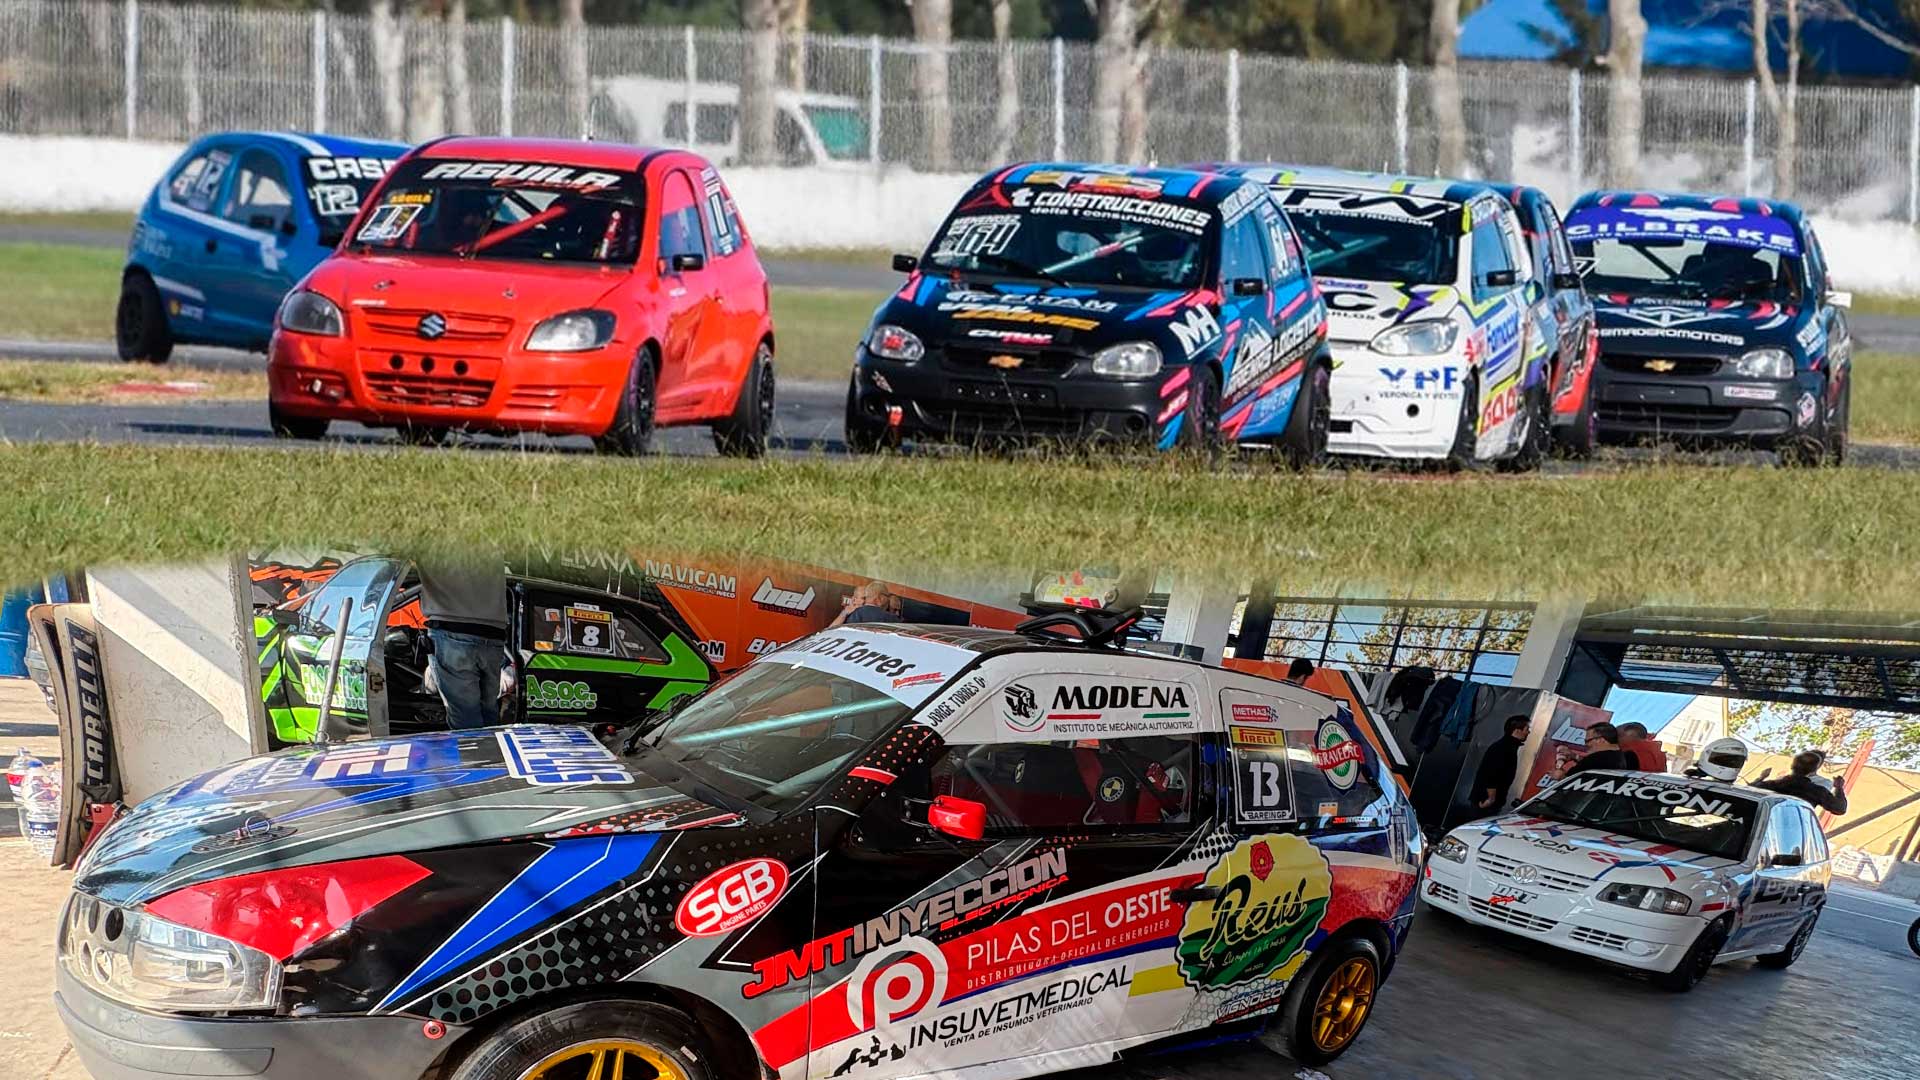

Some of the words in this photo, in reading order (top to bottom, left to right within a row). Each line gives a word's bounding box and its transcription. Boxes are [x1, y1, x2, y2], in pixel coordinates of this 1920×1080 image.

[422, 163, 621, 188] AGUILA
[1034, 191, 1211, 228] CONSTRUCCIONES
[1378, 366, 1458, 390] YPF
[645, 559, 737, 593] NAVICAM
[582, 625, 600, 647] 8
[926, 697, 956, 728] JORGE
[953, 681, 980, 709] TORRES
[1052, 685, 1190, 709] MODENA
[1054, 723, 1096, 734] INSTITUTO
[1098, 723, 1108, 733] DE
[1149, 720, 1195, 732] AUTOMOTRIZ
[1239, 727, 1278, 745] PIRELLI
[1248, 761, 1281, 807] 13
[1566, 776, 1733, 817] MARCONI
[1627, 776, 1692, 794] LOGISTICA
[1502, 832, 1579, 853] AXION
[687, 861, 775, 933] SGB
[940, 874, 1070, 932] ELECTRONICA
[719, 911, 747, 931] ENGINE
[745, 901, 767, 916] PARTS
[966, 925, 1042, 971] PILAS
[1051, 911, 1097, 946] DEL
[1103, 886, 1171, 929] OESTE
[1060, 940, 1102, 961] OFICIAL
[1105, 932, 1117, 948] DE
[1119, 918, 1170, 946] ENERGIZER
[908, 964, 1134, 1049] INSUVETMEDICAL
[943, 1032, 975, 1049] VENTA
[978, 1028, 991, 1038] DE
[993, 1015, 1034, 1035] INSUMOS
[1036, 996, 1094, 1021] VETERINARIO
